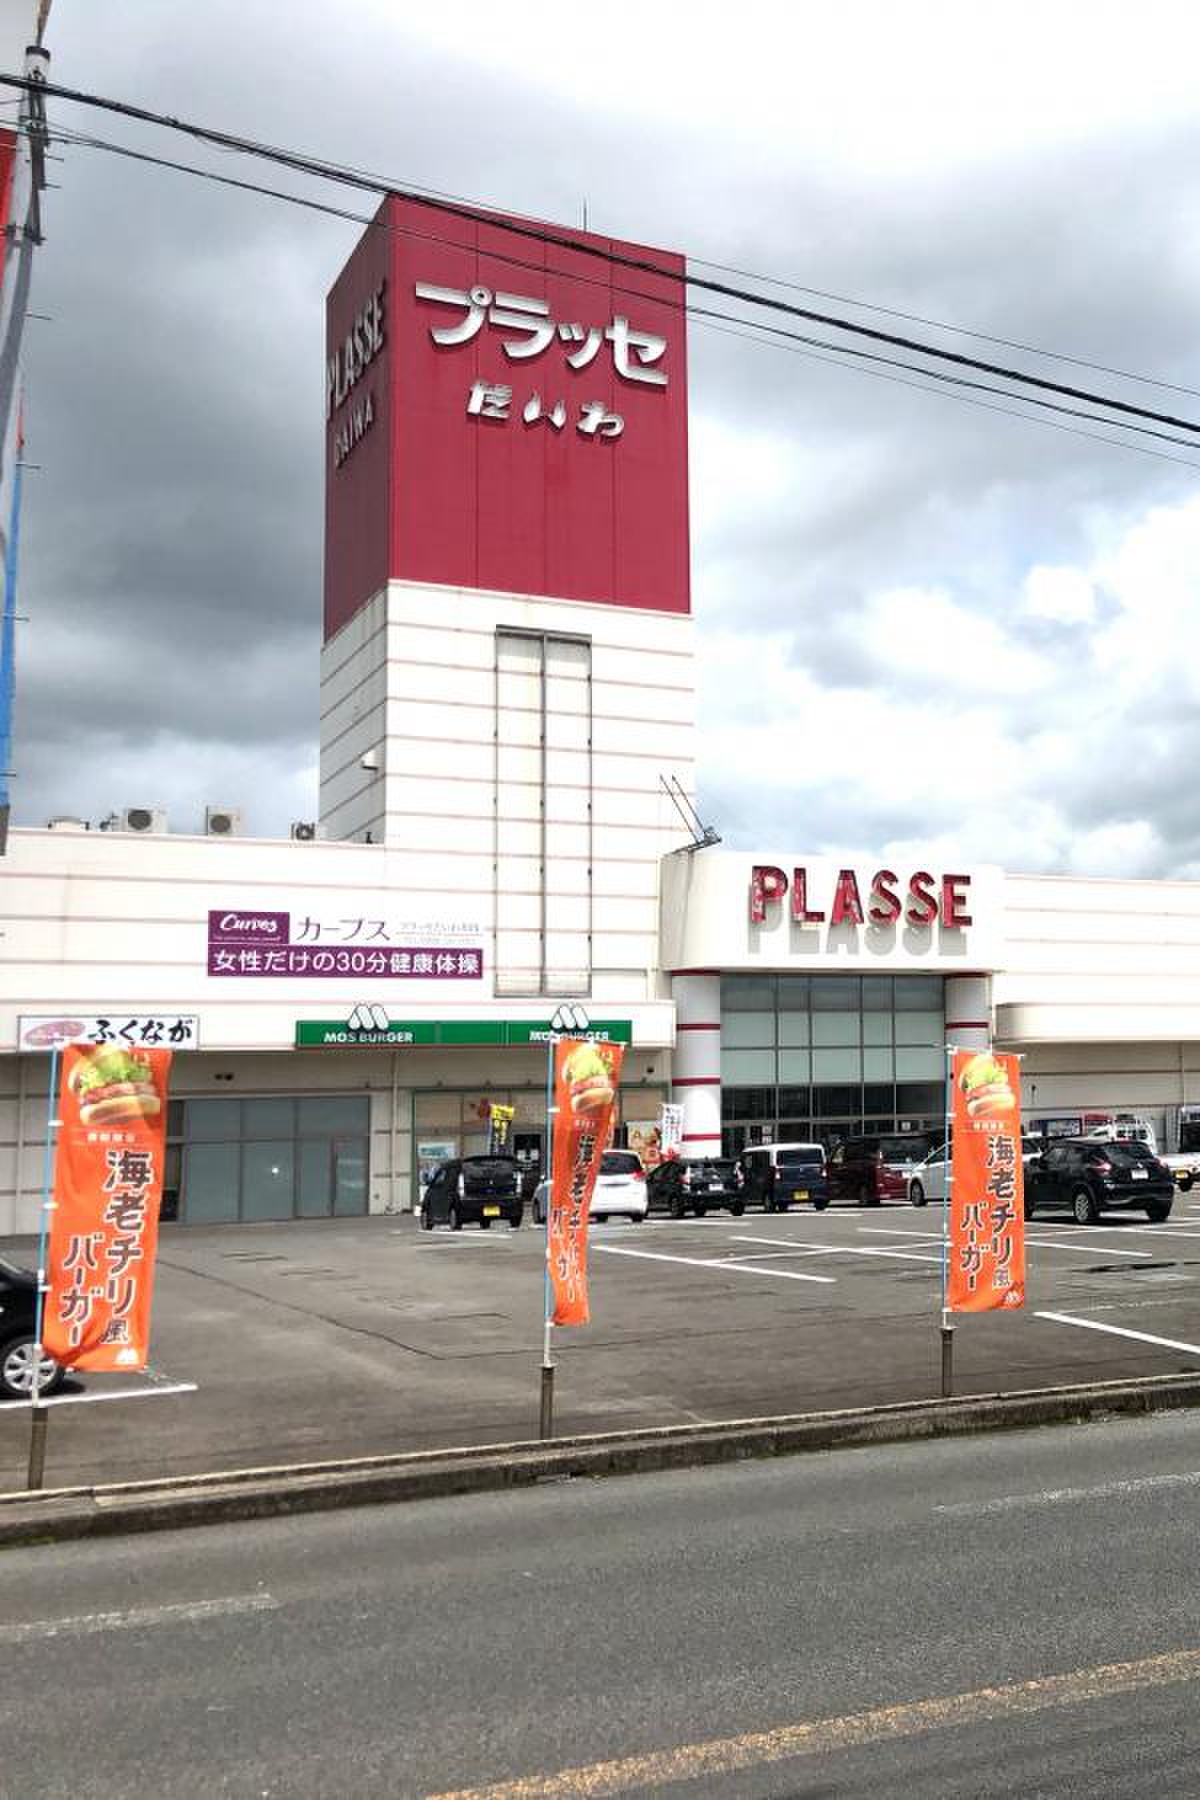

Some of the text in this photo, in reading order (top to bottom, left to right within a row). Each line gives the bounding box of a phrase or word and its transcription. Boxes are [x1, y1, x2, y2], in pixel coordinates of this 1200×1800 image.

[415, 282, 668, 386] プラッセ
[751, 865, 973, 929] PLASSE
[219, 913, 278, 933] Curves
[213, 949, 480, 975] 女性だけの30分健康体操
[87, 1018, 193, 1046] ふくなが
[323, 1031, 413, 1043] MOS BURGER
[958, 1201, 990, 1292] バーガー
[59, 1234, 105, 1346] バーガー
